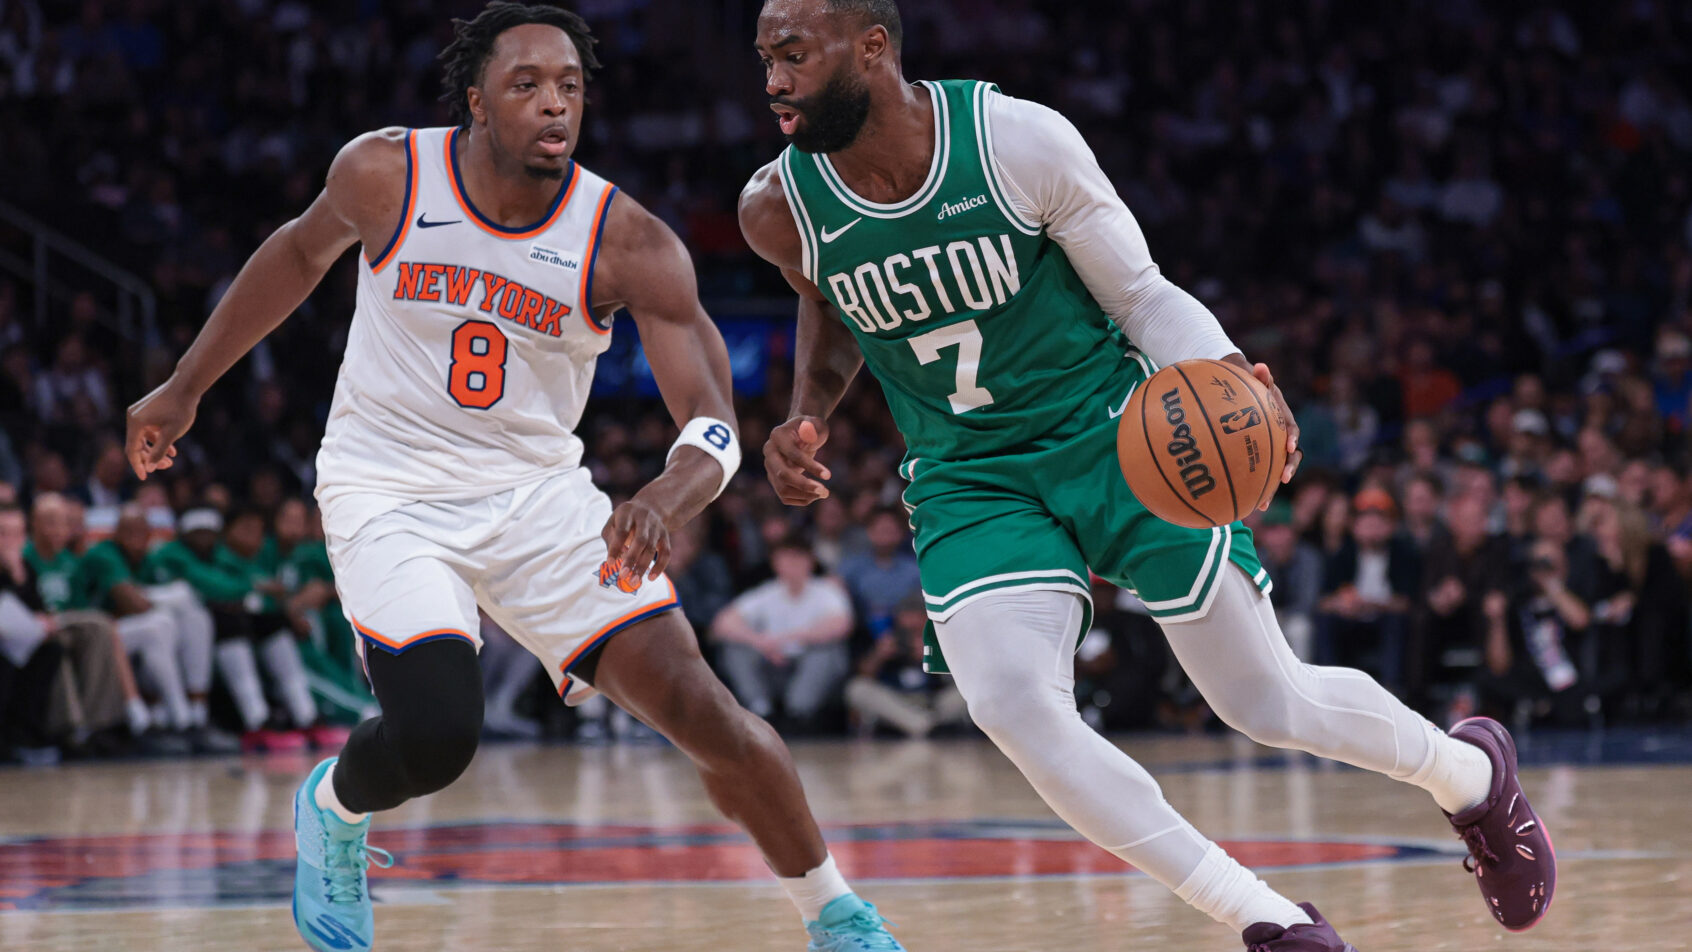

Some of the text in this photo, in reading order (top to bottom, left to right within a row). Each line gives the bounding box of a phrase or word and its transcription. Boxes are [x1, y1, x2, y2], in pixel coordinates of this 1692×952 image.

[937, 194, 988, 220] Amica
[393, 261, 572, 338] NEW YORK
[530, 251, 578, 270] abu dhabi
[827, 234, 1021, 333] BOSTON
[447, 319, 509, 410] 8
[907, 319, 994, 415] 7
[702, 423, 731, 451] 8
[1160, 386, 1217, 501] Wilson
